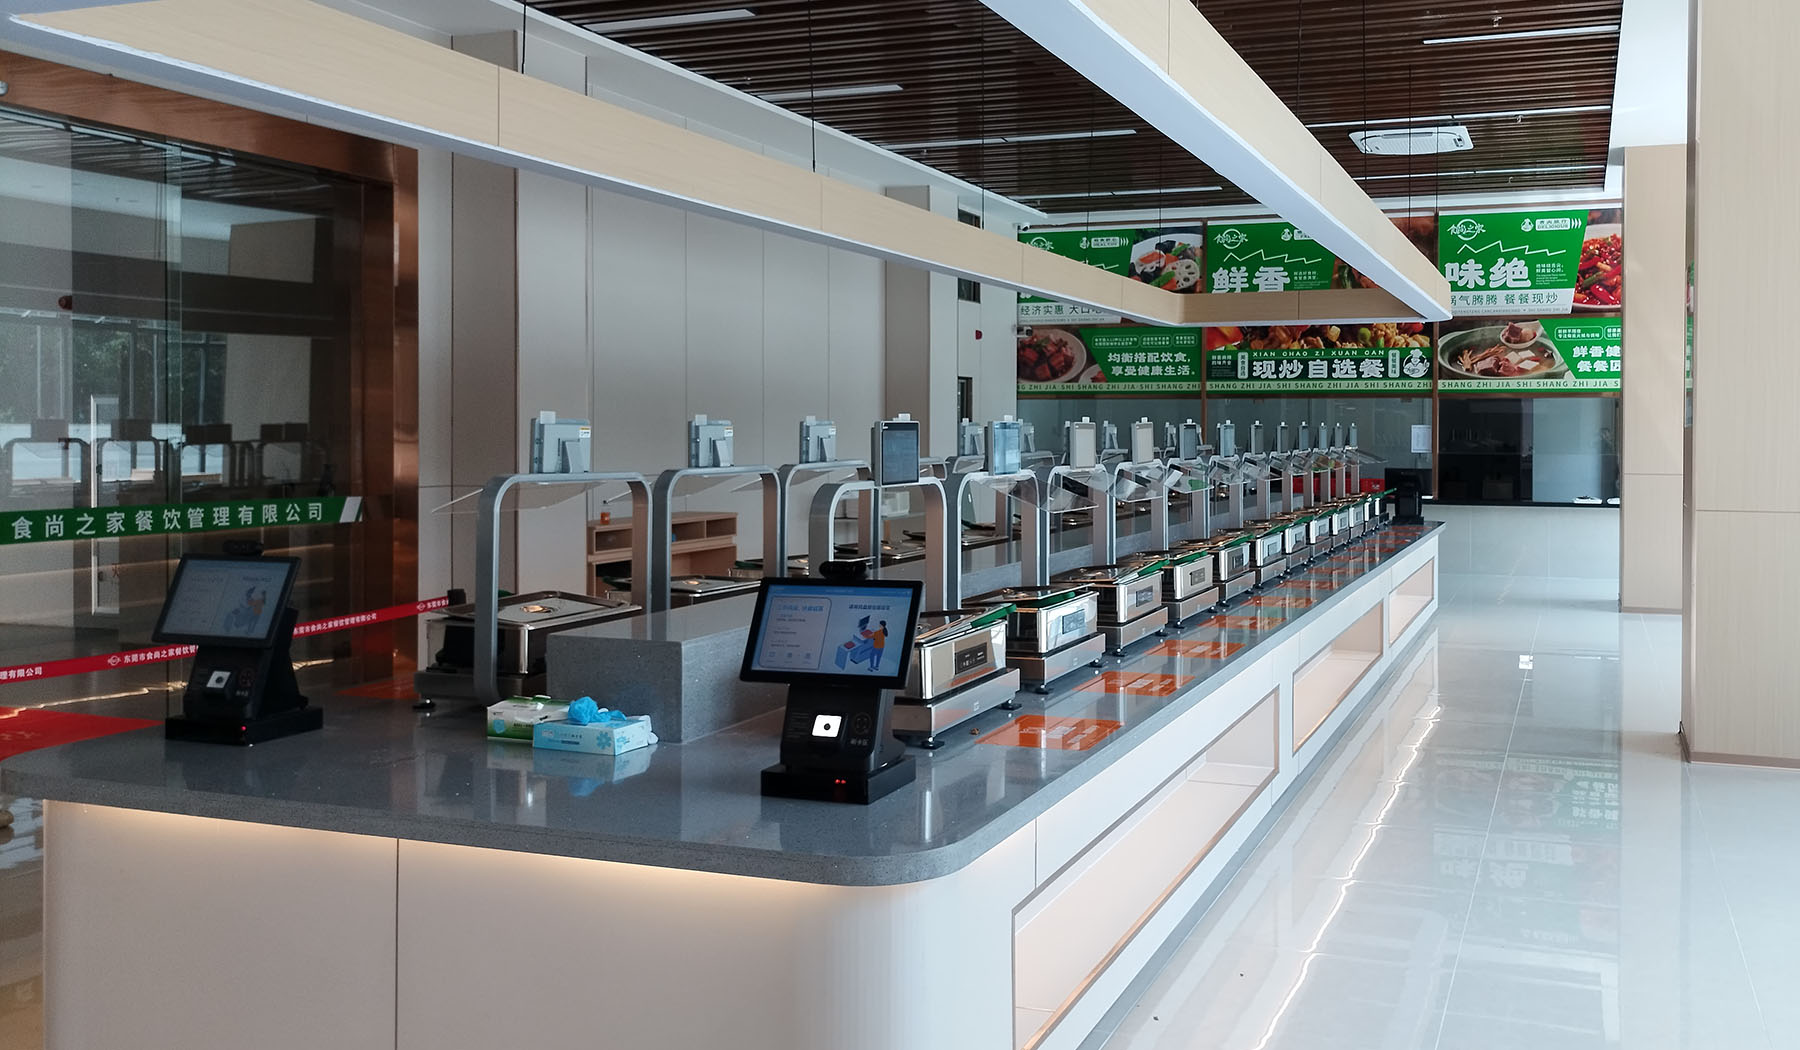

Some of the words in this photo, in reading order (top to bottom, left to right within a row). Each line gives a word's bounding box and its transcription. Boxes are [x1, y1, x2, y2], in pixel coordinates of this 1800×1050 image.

[1212, 265, 1291, 294] 鲜香
[1445, 257, 1532, 289] 味绝
[1504, 292, 1559, 305] 餐餐现炒
[1021, 305, 1064, 316] 经济实惠
[1252, 358, 1385, 379] 现炒自选餐
[11, 502, 323, 540] 食尚之家餐饮管理有限公司
[123, 645, 199, 663] 东莞市食尚之家餐饮管
